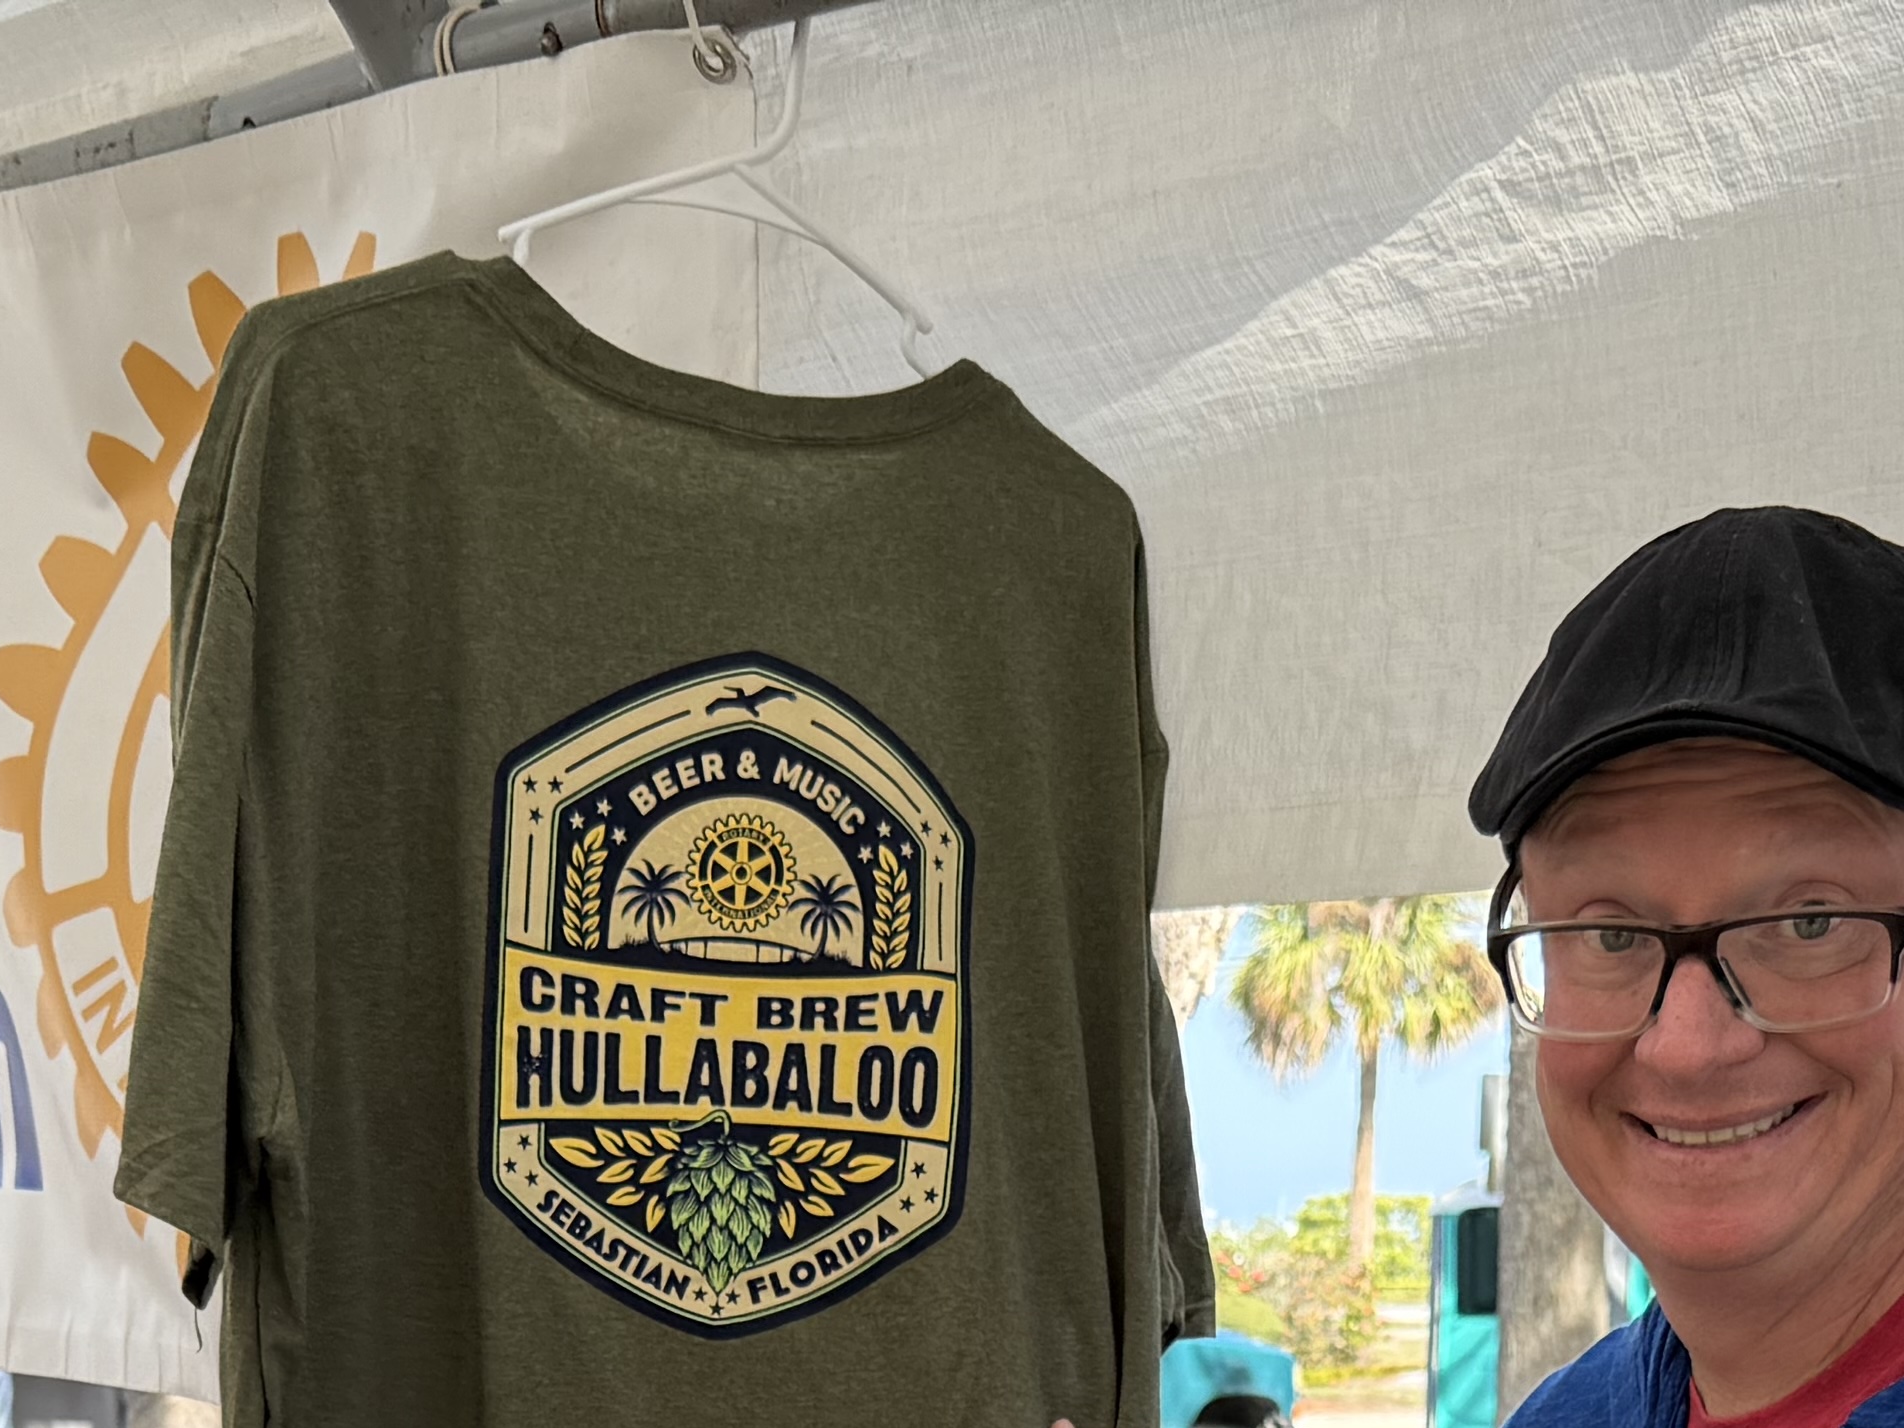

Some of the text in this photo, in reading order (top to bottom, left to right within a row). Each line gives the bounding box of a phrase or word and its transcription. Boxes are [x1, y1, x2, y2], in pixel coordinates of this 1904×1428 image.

[628, 749, 866, 836] BEER & MUSIC
[722, 828, 767, 842] ROTARY
[518, 966, 944, 1034] CRAFT BREW
[515, 1025, 939, 1129] HULLABALOO
[536, 1189, 690, 1301] SEBASTIAN
[748, 1221, 899, 1305] FLORIDA
